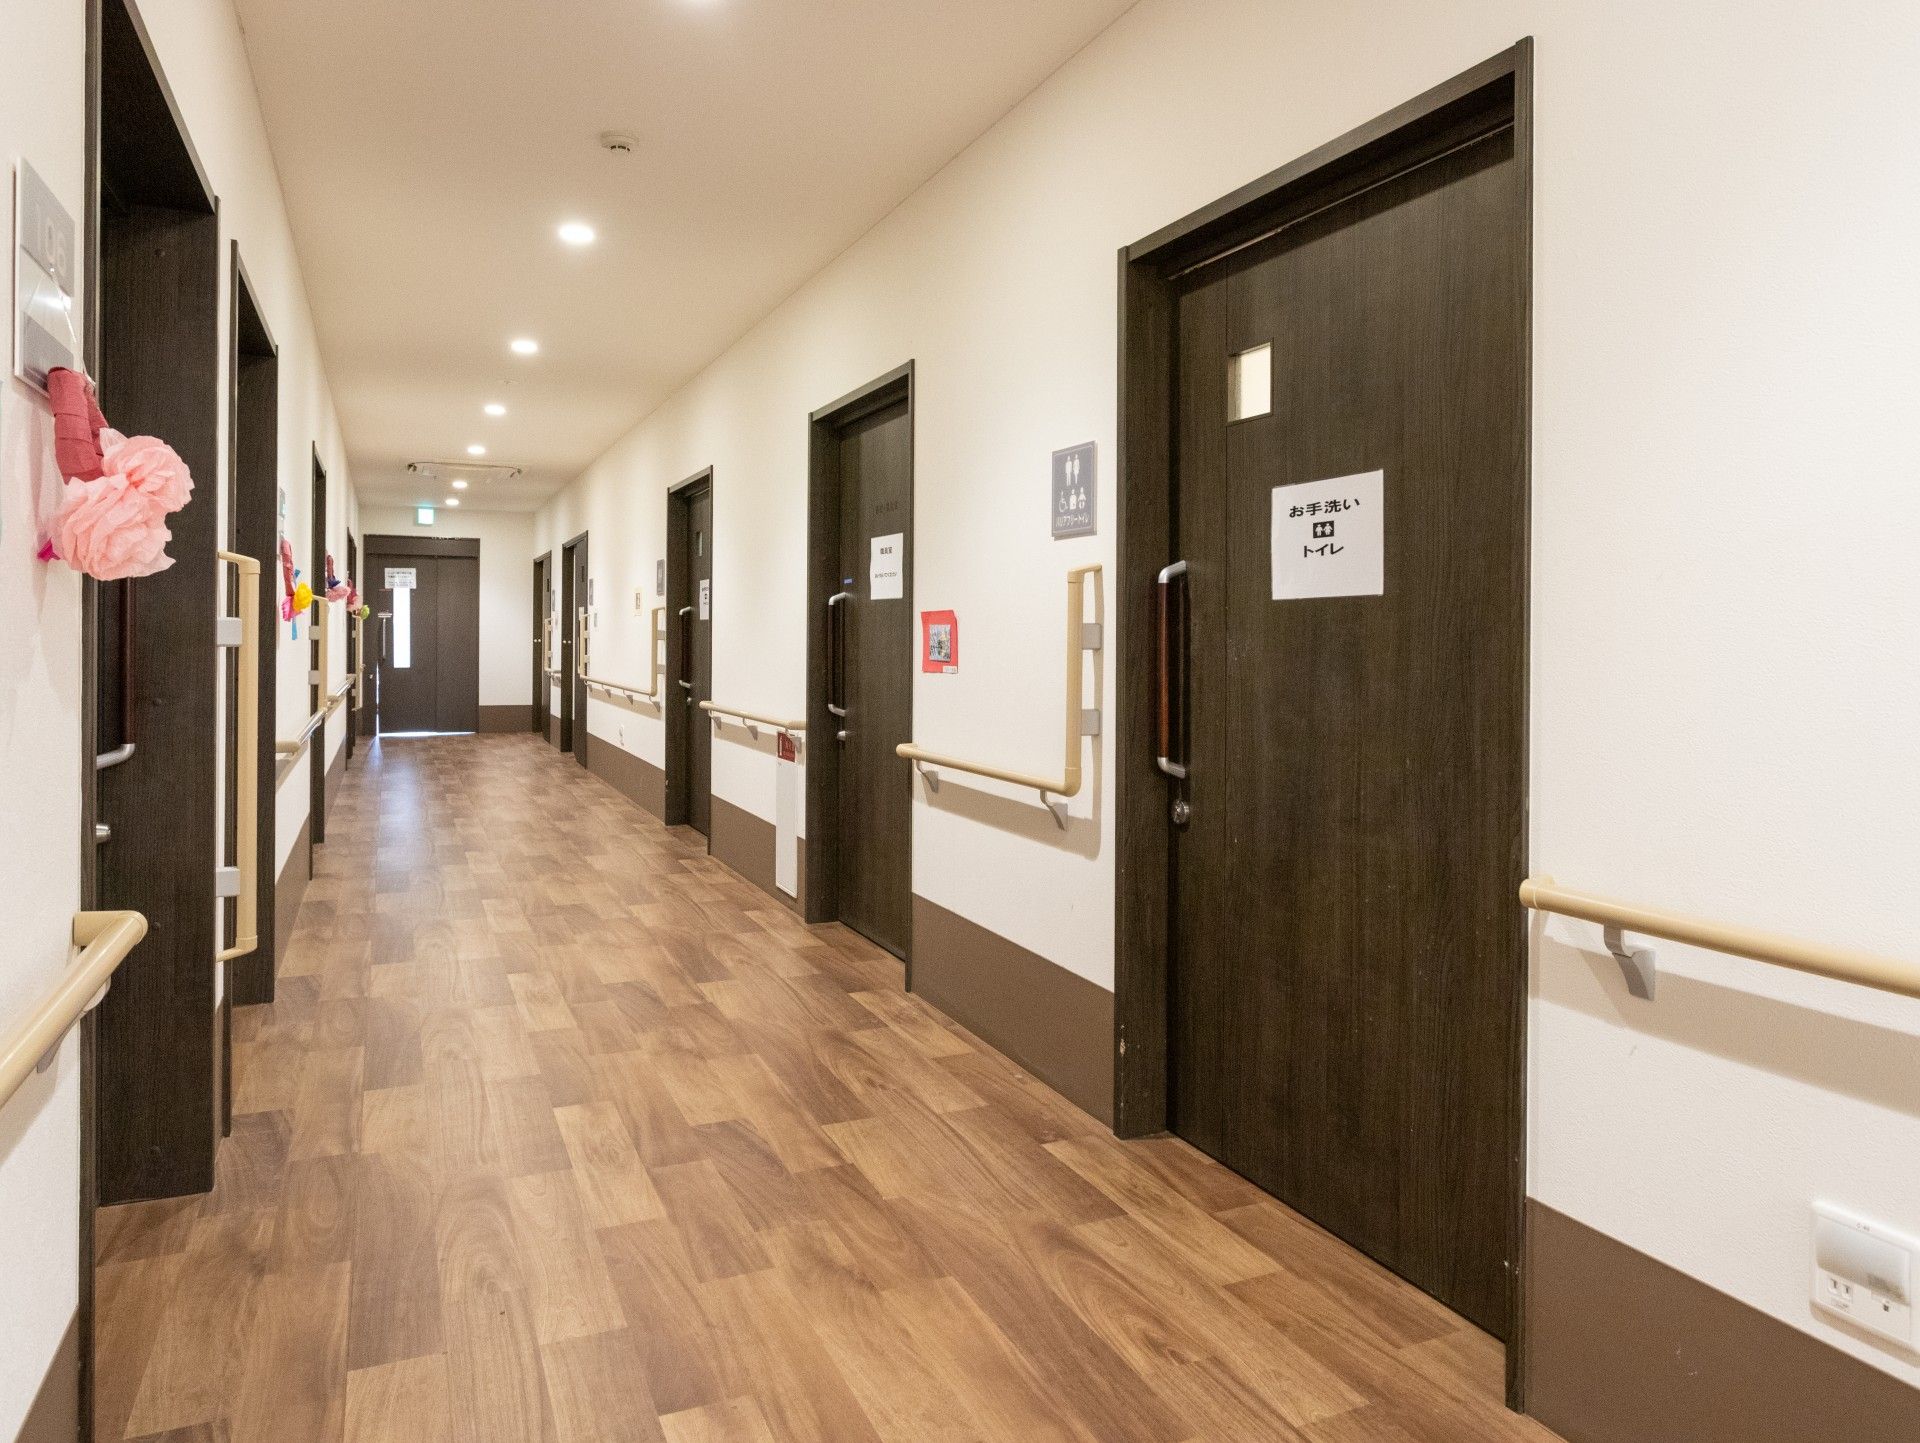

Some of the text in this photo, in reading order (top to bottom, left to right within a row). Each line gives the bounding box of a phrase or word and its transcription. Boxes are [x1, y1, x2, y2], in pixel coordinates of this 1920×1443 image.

[1289, 498, 1360, 518] お手洗い
[1303, 543, 1344, 558] トイレ
